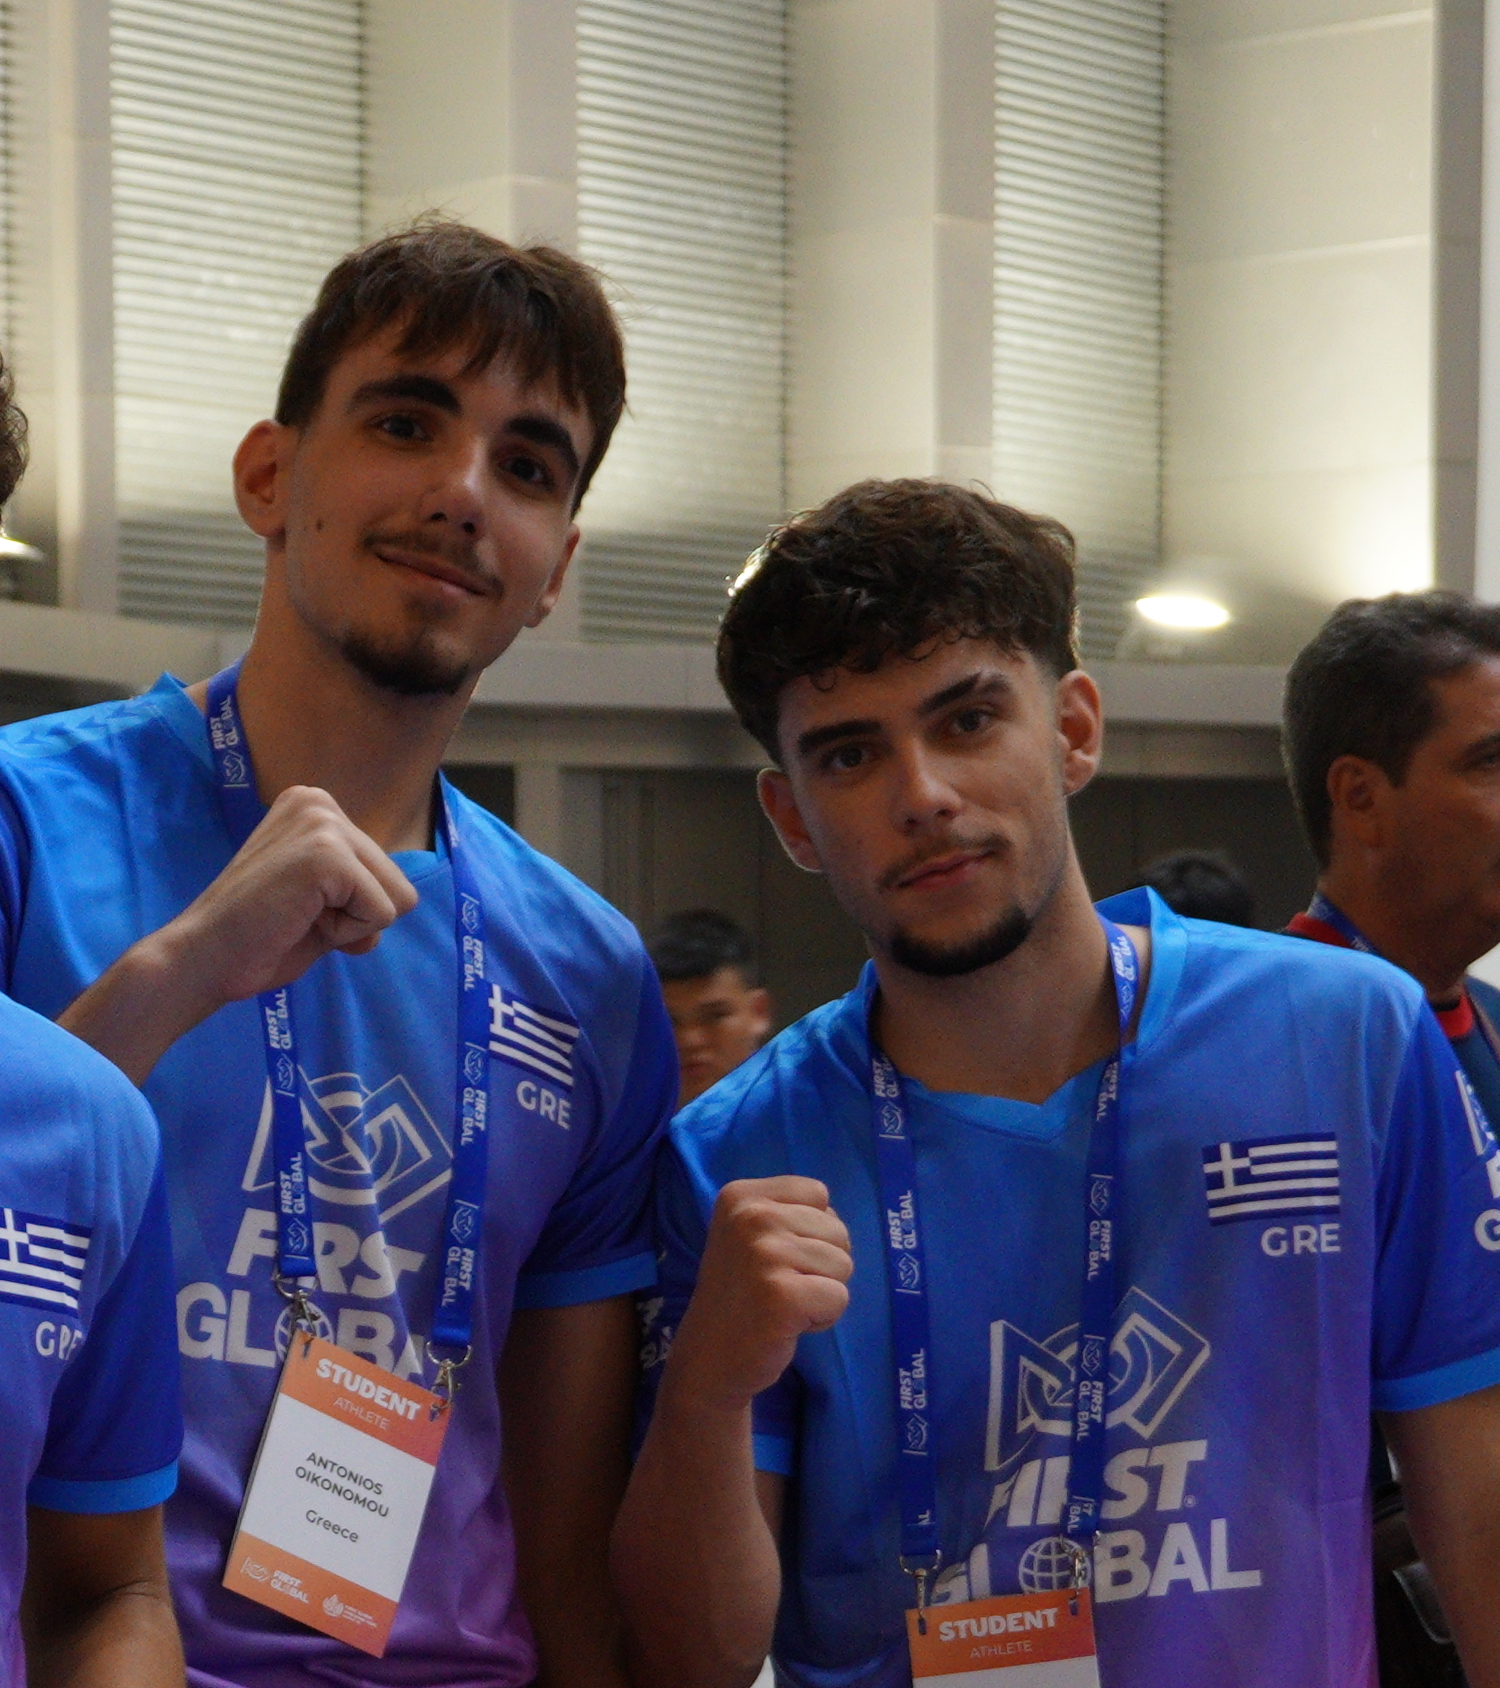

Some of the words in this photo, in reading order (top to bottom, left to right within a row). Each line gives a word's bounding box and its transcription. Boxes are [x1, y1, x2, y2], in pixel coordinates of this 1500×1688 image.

[472, 938, 484, 979] FIRST
[265, 1005, 281, 1049] FIRST
[474, 1089, 487, 1132] FIRST
[516, 1079, 573, 1131] GRE
[280, 1170, 293, 1214] FIRST
[887, 1208, 902, 1250] FIRST
[1100, 1219, 1112, 1262] FIRST
[1260, 1223, 1341, 1257] GRE
[226, 1207, 427, 1300] FRST
[458, 1247, 476, 1291] FIRST
[315, 1357, 421, 1420] STUDENT
[899, 1367, 913, 1410] FIRST
[1090, 1380, 1104, 1424] FIRST
[333, 1396, 391, 1431] ATHLETE
[295, 1466, 389, 1518] OIKONOMOU
[305, 1452, 384, 1496] ANTONIOS
[305, 1509, 359, 1543] Greece
[938, 1607, 1059, 1643] STUDENT
[969, 1639, 1033, 1660] ATHLETE
